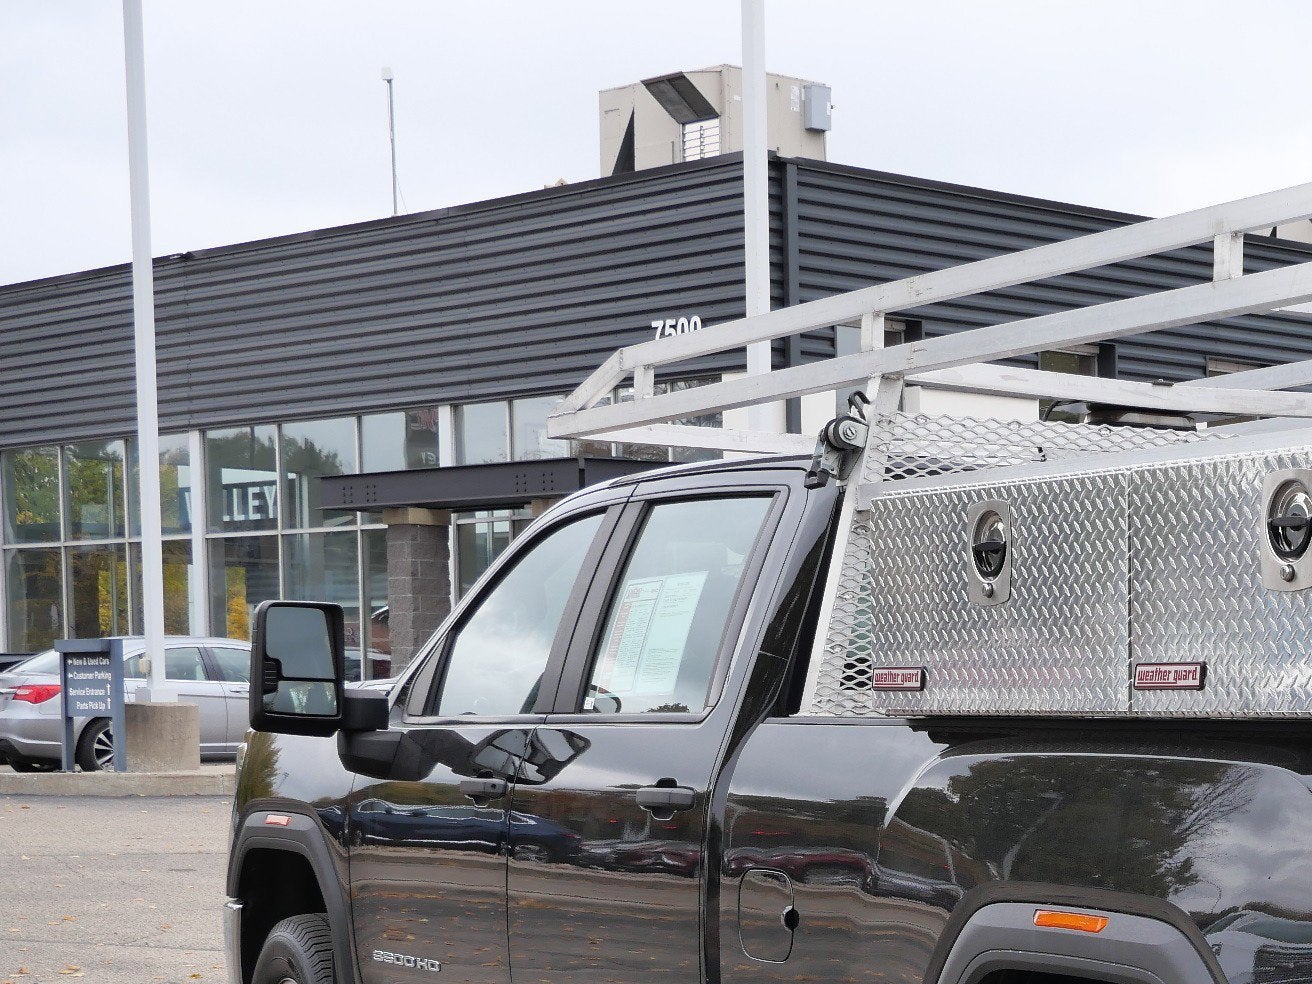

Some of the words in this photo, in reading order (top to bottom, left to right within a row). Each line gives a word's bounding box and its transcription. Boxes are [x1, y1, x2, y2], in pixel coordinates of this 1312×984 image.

[651, 315, 702, 341] 7500
[72, 657, 82, 666] New
[87, 656, 99, 666] Used
[99, 656, 110, 666] Cars
[73, 671, 95, 680] Customer
[94, 670, 112, 681] Parking
[874, 670, 900, 683] weather
[900, 670, 920, 683] guard
[1137, 667, 1171, 682] weather
[1173, 666, 1198, 682] guard
[69, 687, 86, 696] Service
[85, 687, 106, 696] Entrance
[76, 701, 89, 710] Parts
[88, 701, 99, 710] Pick
[99, 701, 106, 712] Up
